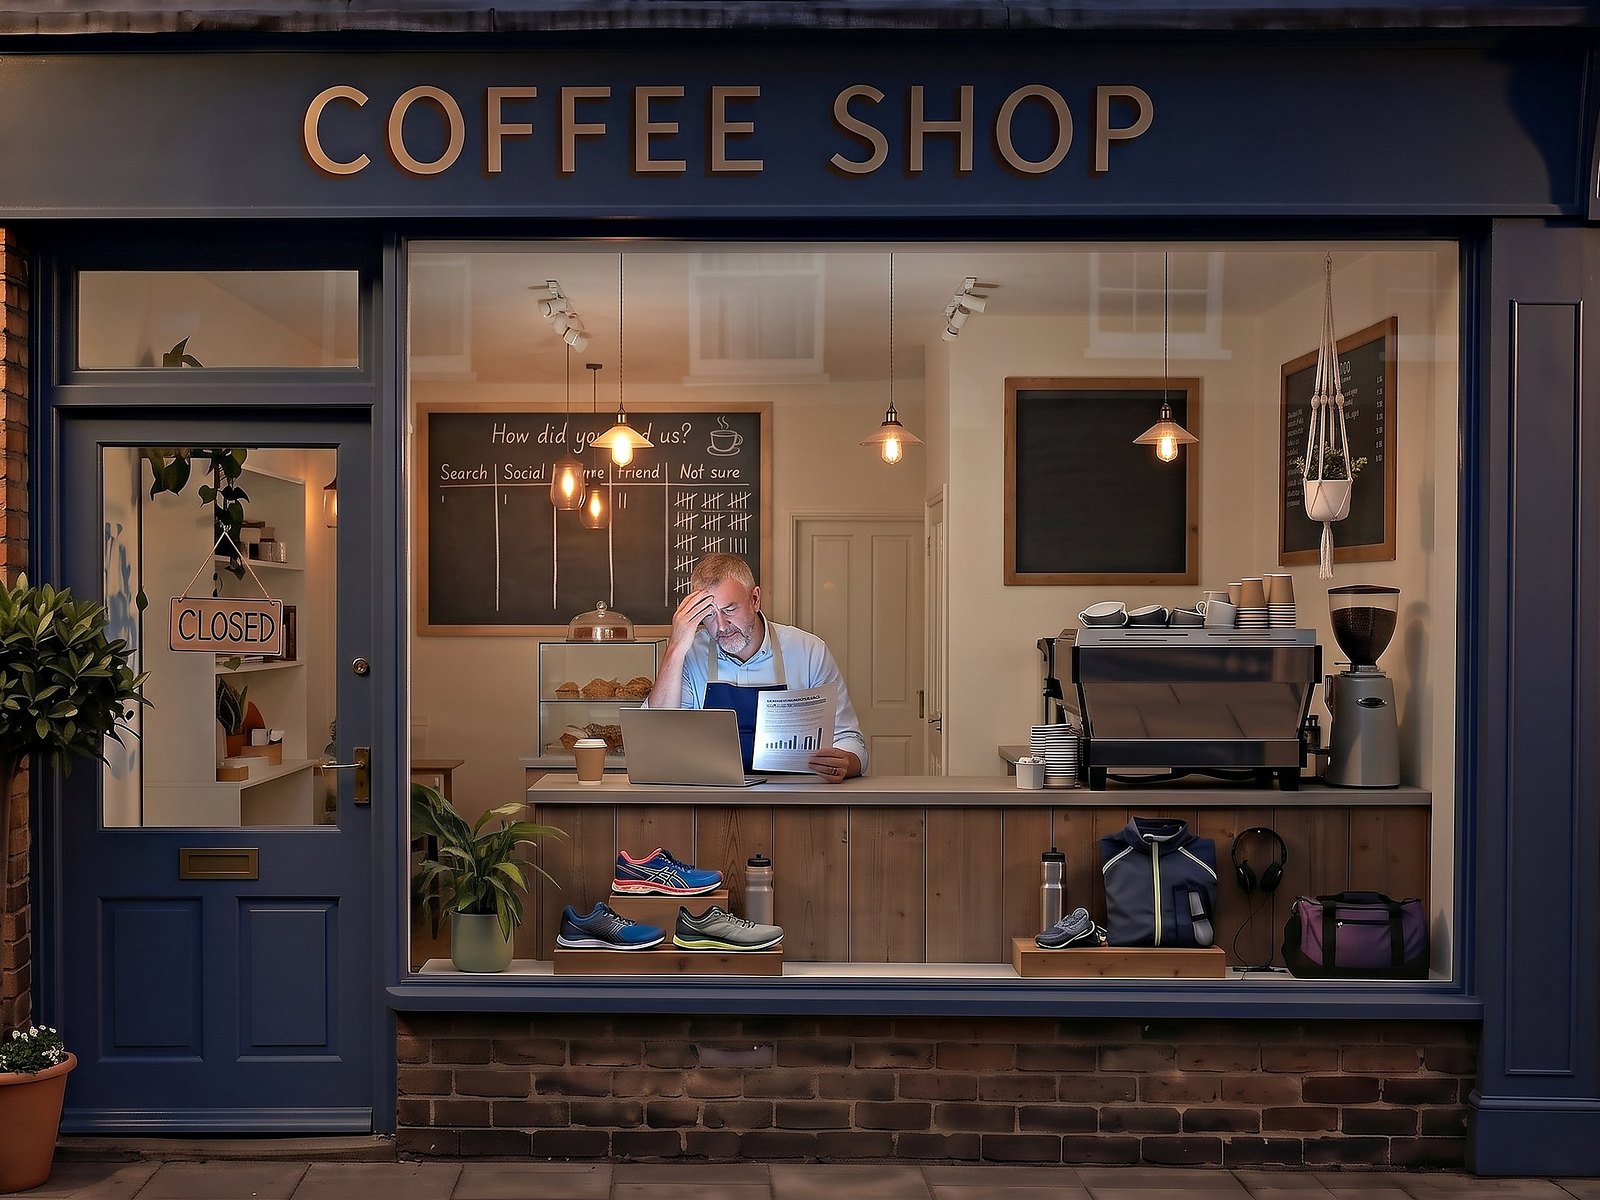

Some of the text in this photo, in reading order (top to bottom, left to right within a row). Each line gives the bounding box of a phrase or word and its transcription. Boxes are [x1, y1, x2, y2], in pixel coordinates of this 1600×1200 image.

[302, 84, 1156, 175] COFFEE SHOP
[492, 423, 530, 444] How
[537, 422, 567, 444] did
[573, 431, 601, 454] yo
[660, 422, 692, 444] us?
[440, 463, 488, 480] Search
[504, 463, 545, 480] Social
[680, 463, 741, 479] Not sure
[178, 608, 275, 643] CLOSED
